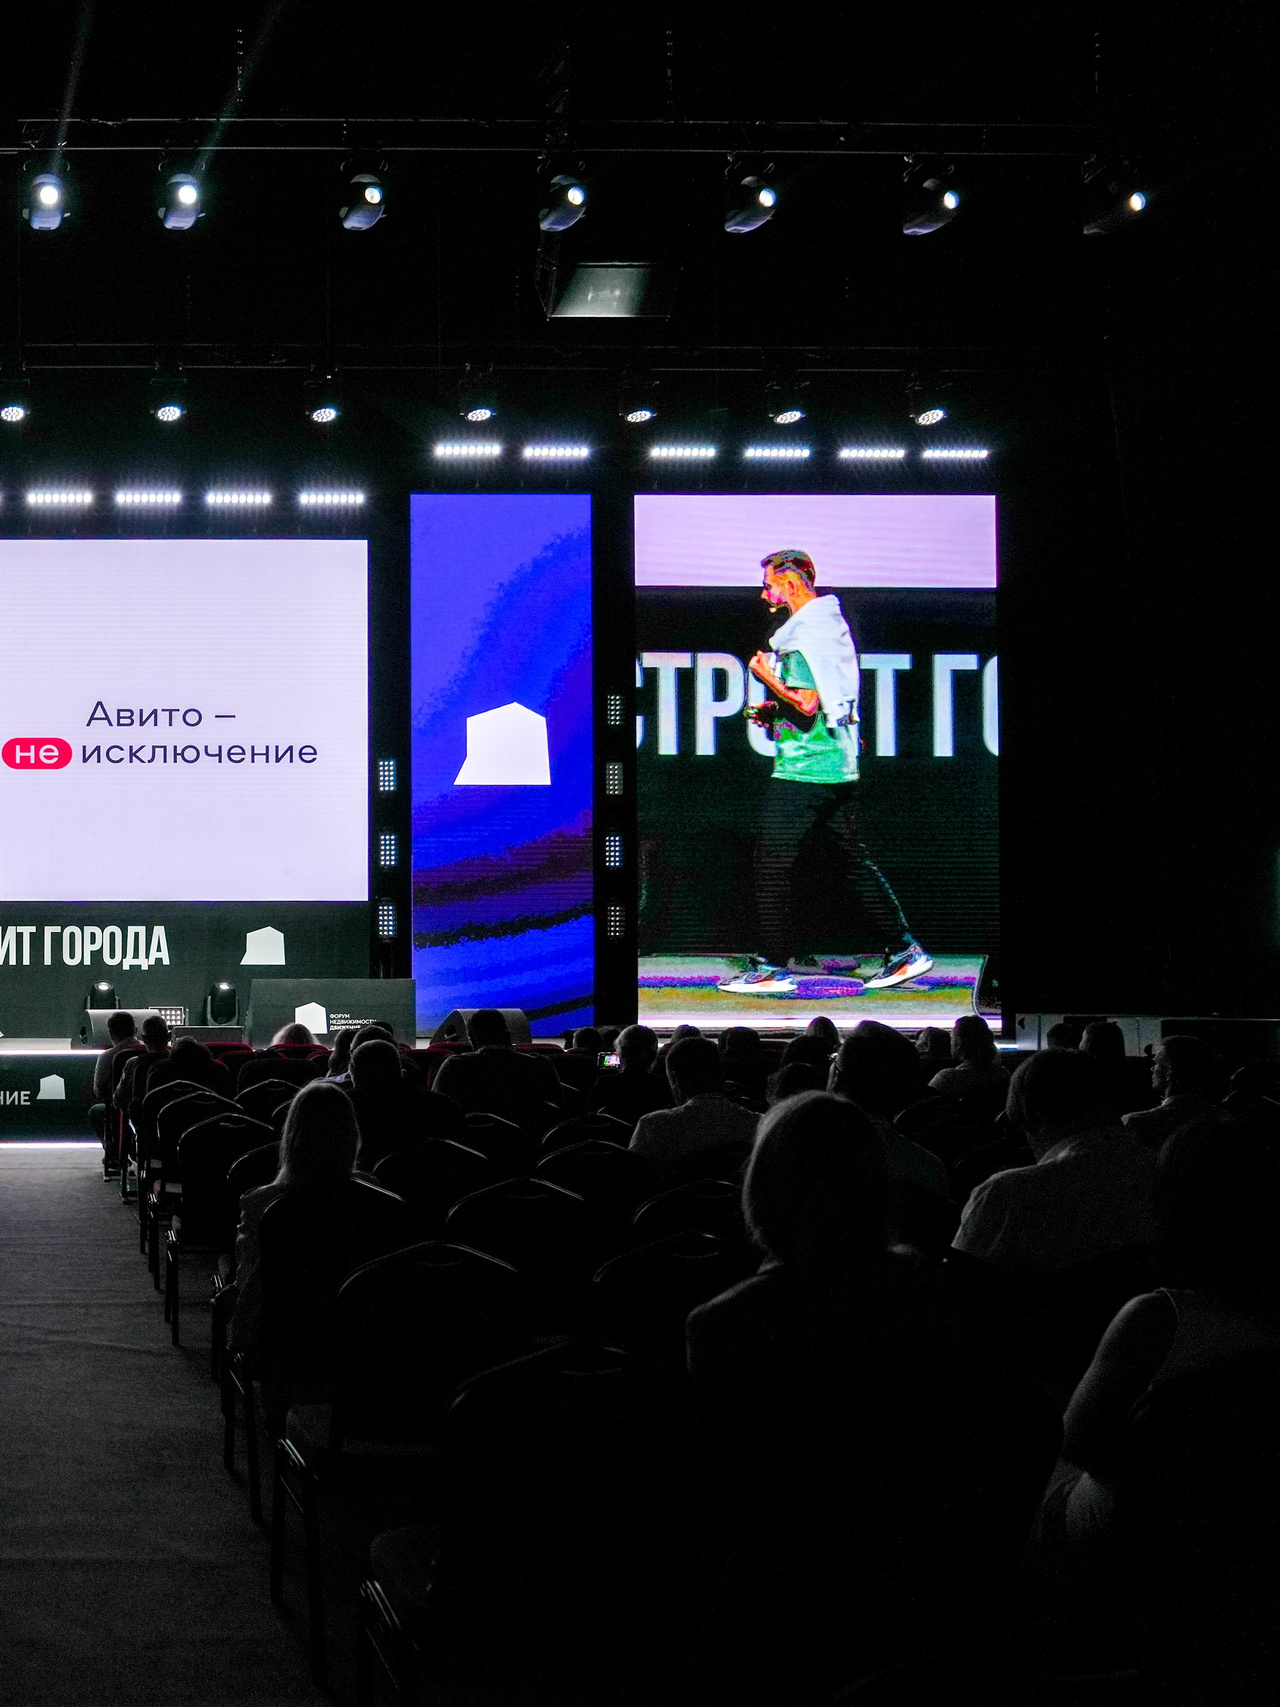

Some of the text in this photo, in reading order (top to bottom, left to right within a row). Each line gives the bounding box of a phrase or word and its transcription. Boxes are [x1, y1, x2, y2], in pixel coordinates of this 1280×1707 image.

[85, 700, 203, 727] Авито
[15, 744, 317, 764] не исключение
[43, 925, 170, 970] ГОРОДА
